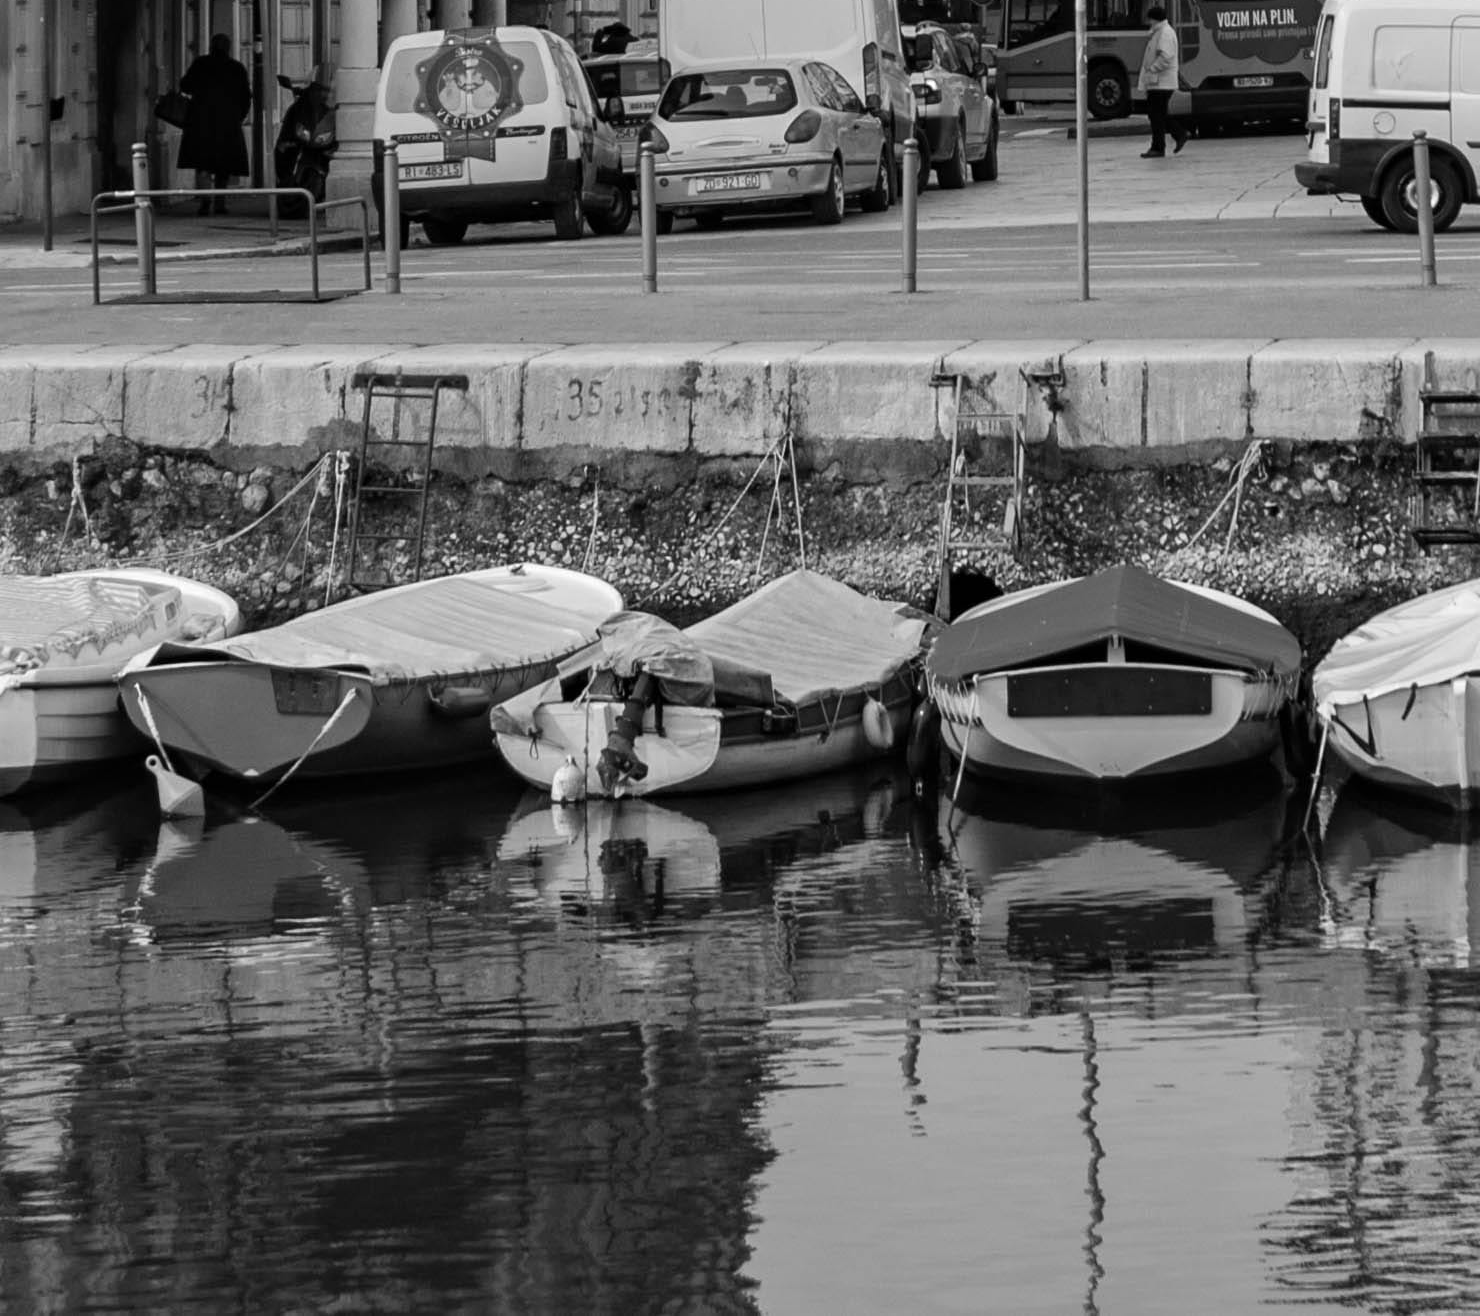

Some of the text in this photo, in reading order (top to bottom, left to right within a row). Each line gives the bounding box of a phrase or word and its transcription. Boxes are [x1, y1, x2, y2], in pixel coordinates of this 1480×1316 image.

[1216, 8, 1299, 28] VOZIM NA PLIN.
[436, 108, 501, 129] VESELJAK
[396, 132, 439, 143] CITROËN
[568, 378, 604, 421] 35
